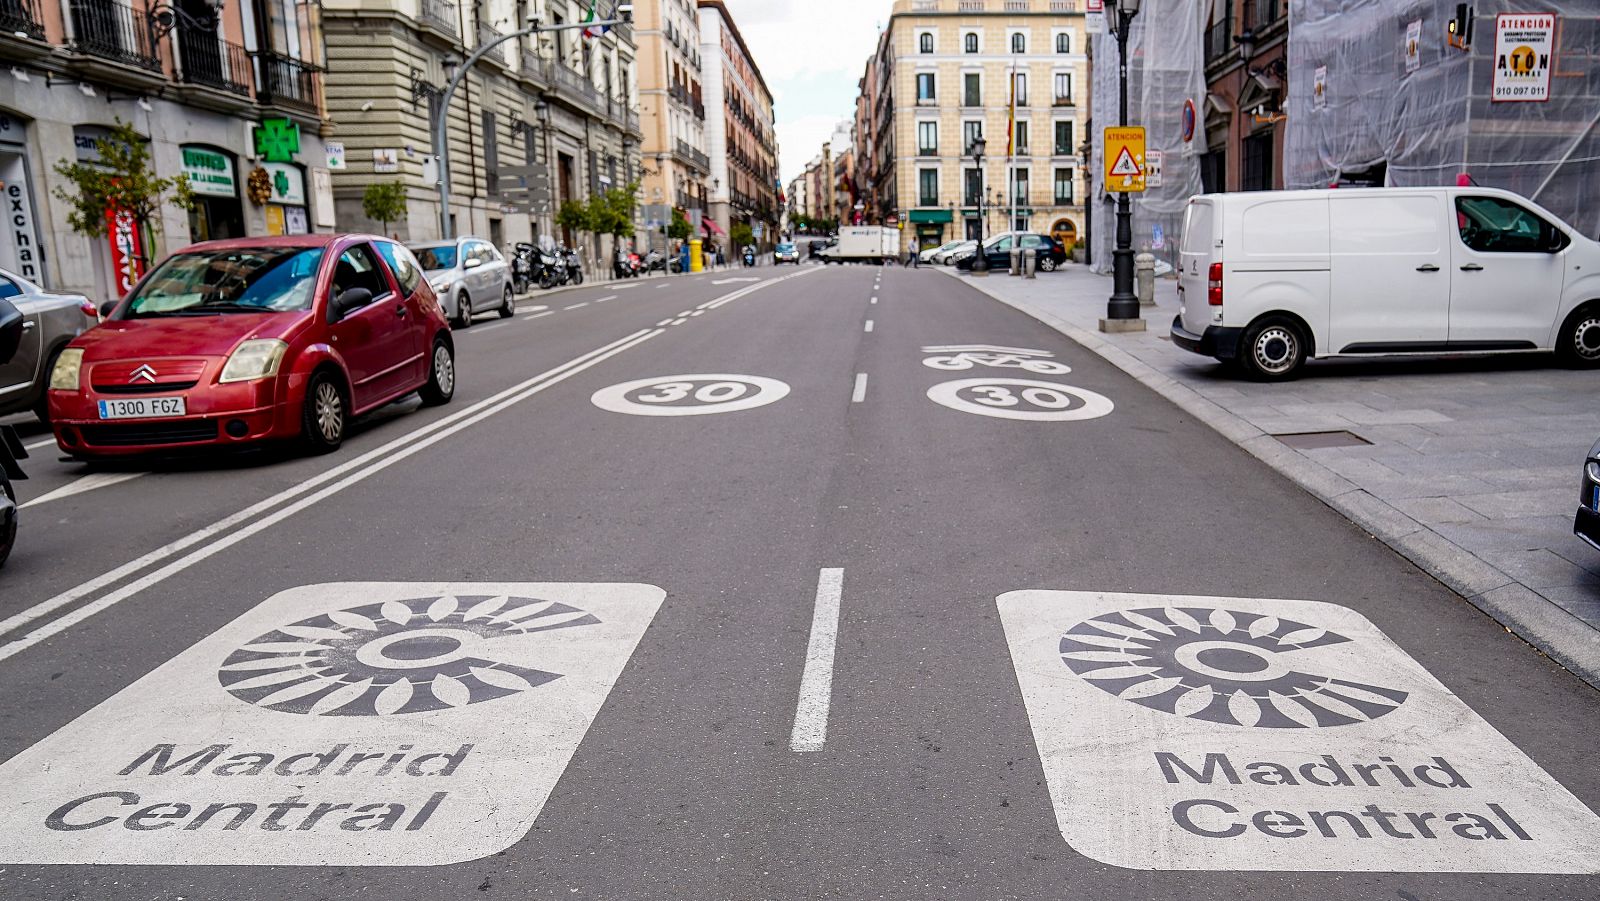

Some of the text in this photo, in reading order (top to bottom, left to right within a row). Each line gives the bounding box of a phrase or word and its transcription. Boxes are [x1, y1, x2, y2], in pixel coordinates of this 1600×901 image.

[1501, 18, 1550, 29] ATENCIÓN
[1498, 51, 1548, 69] ATÓN
[1496, 87, 1545, 95] 910 097 011
[638, 382, 748, 403] 30
[970, 385, 1071, 409] 30
[111, 399, 180, 416] 1300 FGZ
[118, 744, 474, 778] Madrid
[1154, 751, 1472, 789] Madrid
[45, 791, 448, 833] Central
[1171, 799, 1533, 841] Central
